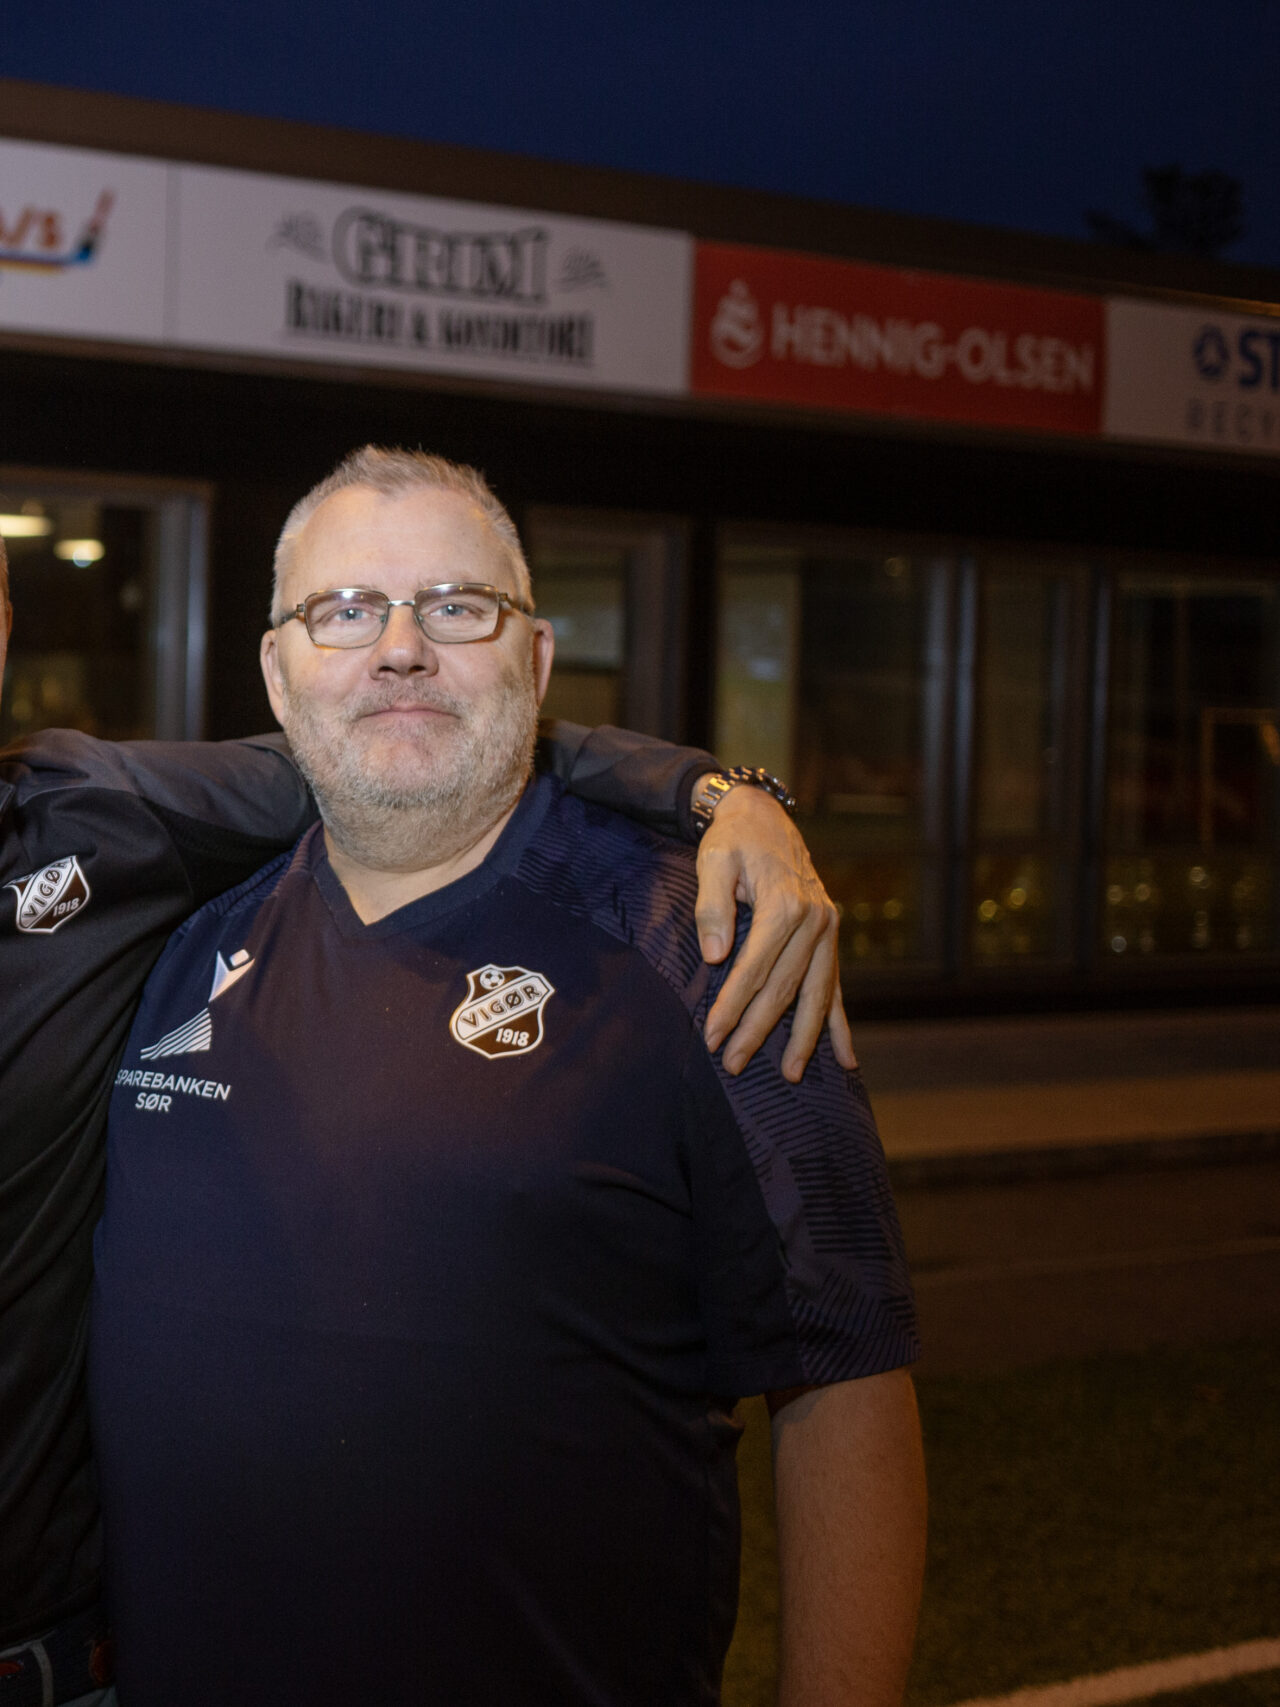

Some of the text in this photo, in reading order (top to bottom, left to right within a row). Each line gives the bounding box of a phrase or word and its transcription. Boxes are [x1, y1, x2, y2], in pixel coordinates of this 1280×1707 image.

[770, 302, 1096, 393] HENNIG-OLSEN
[53, 898, 80, 917] 1918
[461, 985, 540, 1027] VIGØR
[496, 1028, 530, 1047] 1918
[115, 1069, 231, 1101] SPAREBANKEN
[135, 1092, 172, 1113] SØR
